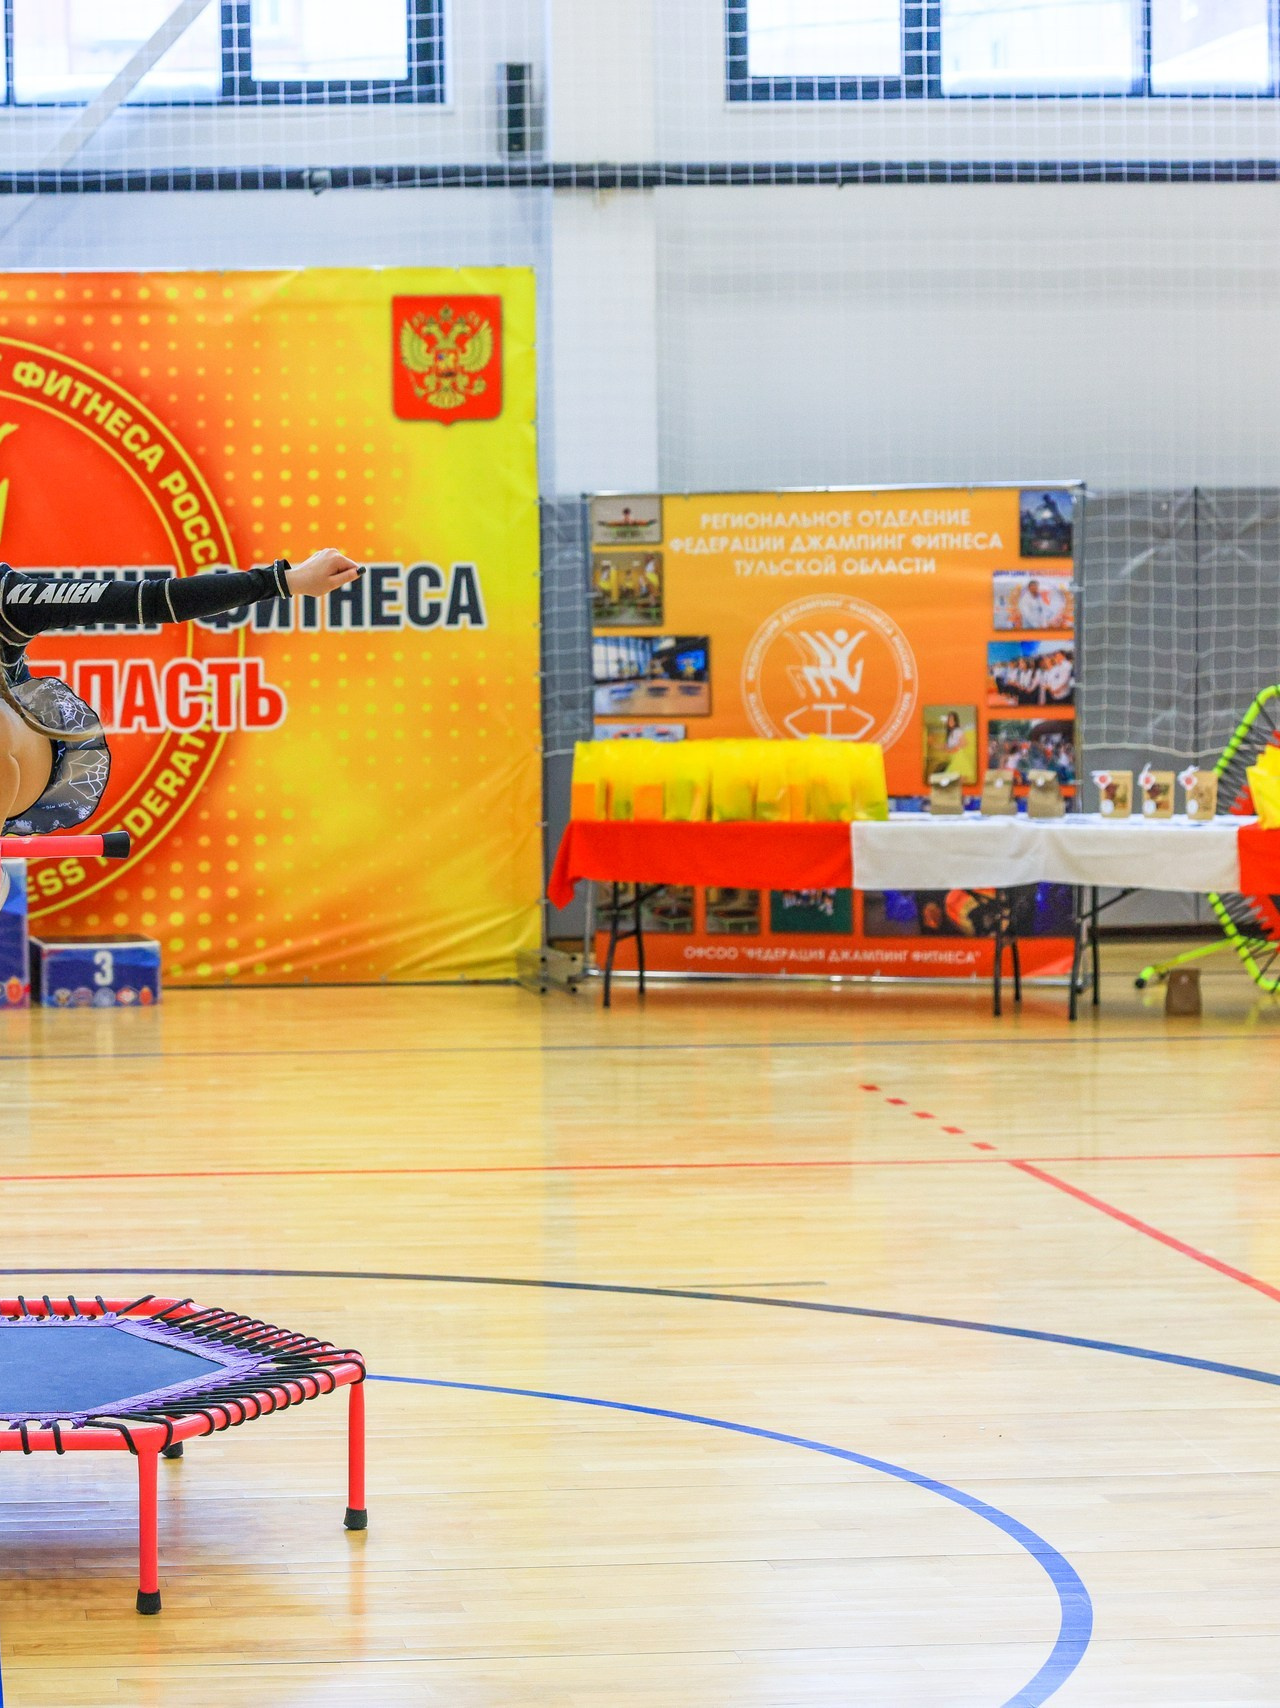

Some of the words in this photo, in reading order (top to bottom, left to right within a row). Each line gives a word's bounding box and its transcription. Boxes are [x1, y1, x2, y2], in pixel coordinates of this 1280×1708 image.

[12, 361, 166, 473] ФИТНЕСА
[158, 470, 220, 572] РОСС
[699, 510, 852, 531] РЕГИОНАЛЬНОЕ
[857, 508, 971, 528] ОТДЕЛЕНИЕ
[670, 536, 785, 555] ФЕДЕРАЦИИ
[789, 533, 906, 553] ДЖАМПИНГ
[911, 532, 1004, 551] ФИТНЕСА
[735, 557, 836, 577] ТУЛЬСКОЙ
[842, 556, 936, 575] ОБЛАСТИ
[7, 582, 38, 604] KL
[34, 579, 113, 605] ALIEN
[26, 657, 287, 734] ЛАСТЬ
[93, 950, 114, 986] 3
